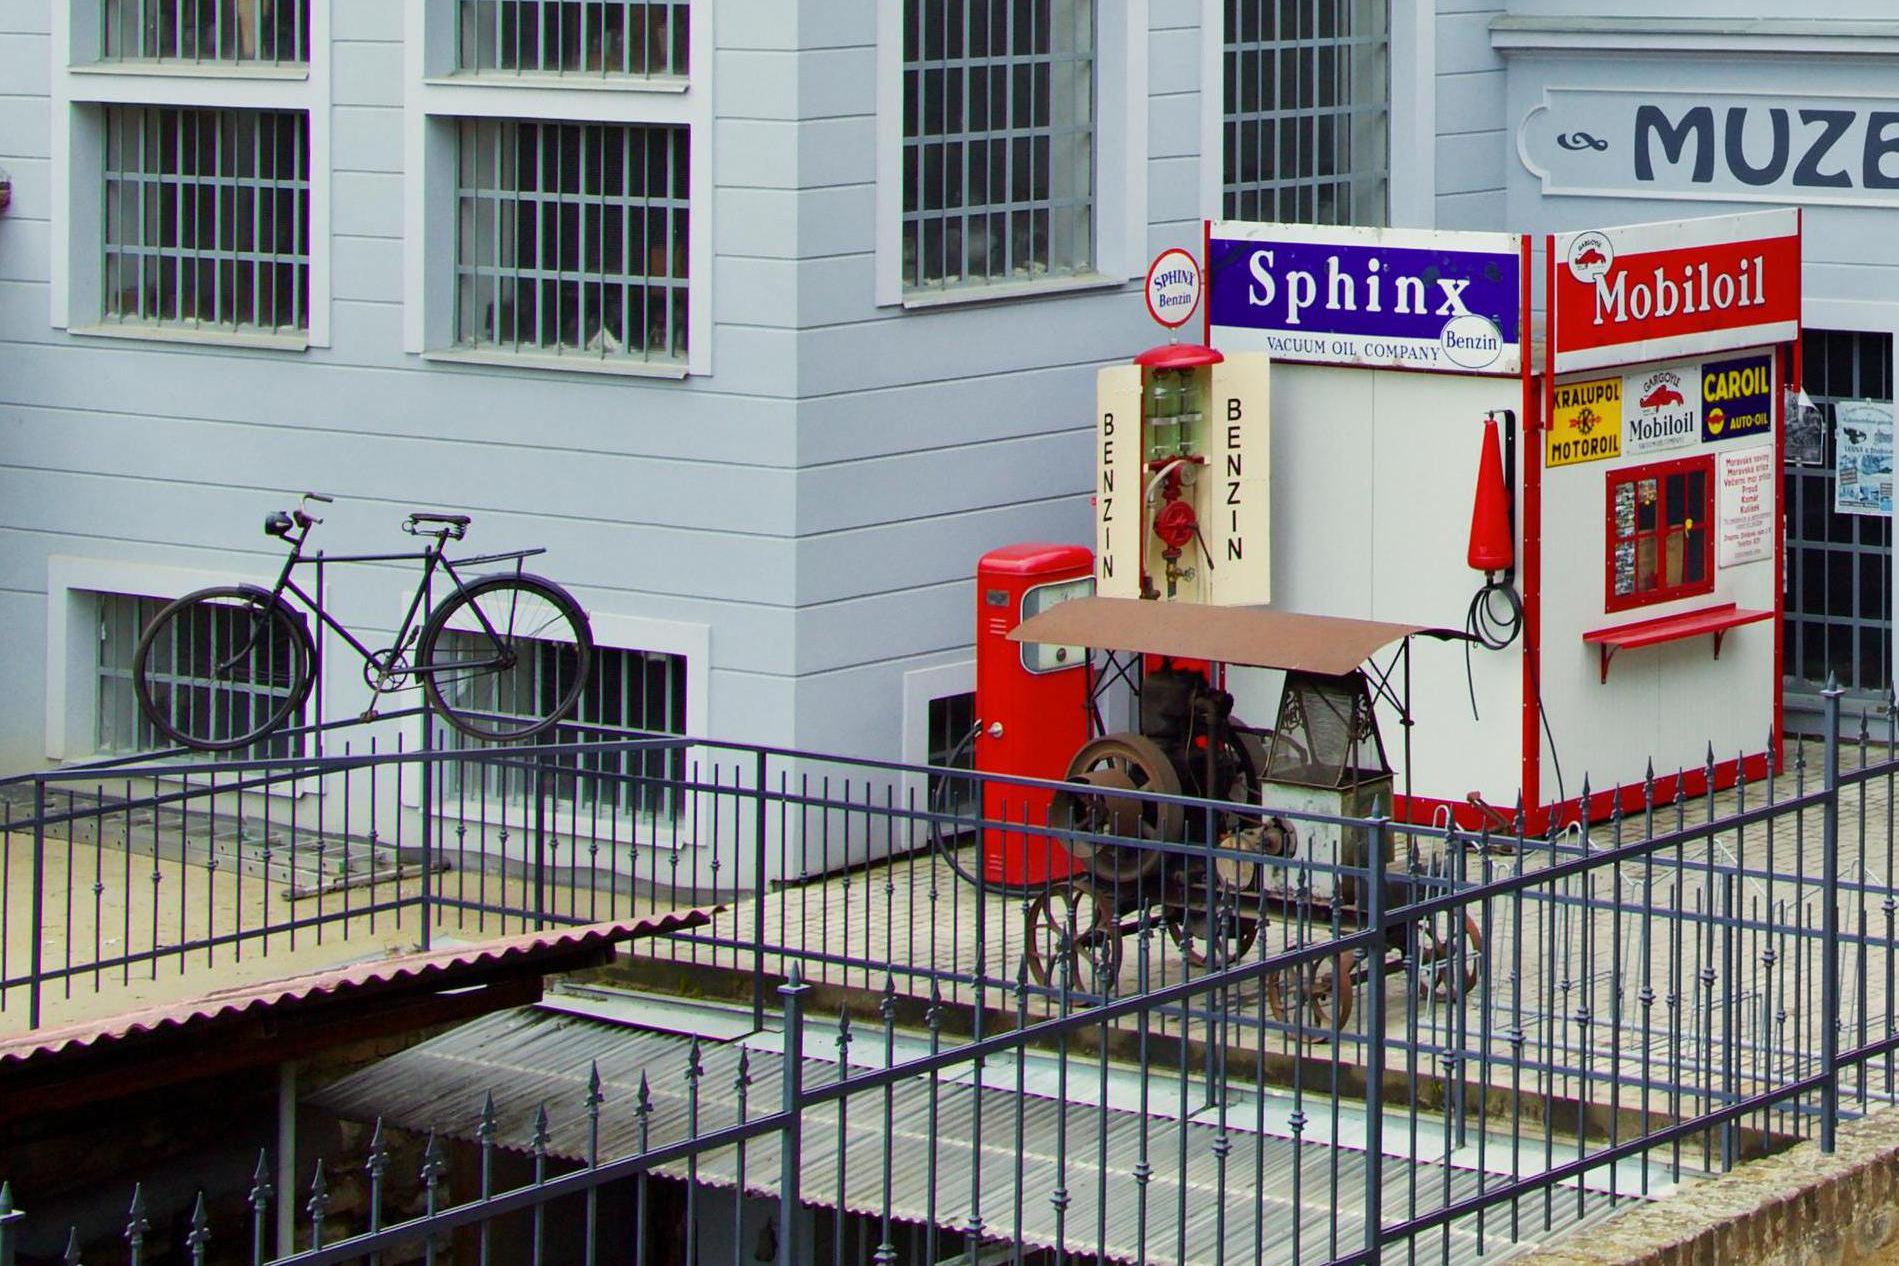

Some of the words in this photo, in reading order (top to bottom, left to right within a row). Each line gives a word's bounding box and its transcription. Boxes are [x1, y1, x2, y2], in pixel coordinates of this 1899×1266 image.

[1154, 270, 1195, 291] SPHINX
[1249, 250, 1471, 324] Sphinx
[1592, 255, 1766, 326] Mobiloil
[1160, 293, 1191, 307] Benzin
[1267, 336, 1326, 354] VACUUM
[1332, 341, 1357, 356] OIL
[1364, 343, 1440, 361] COMPANY
[1446, 330, 1498, 351] Benzin
[1643, 372, 1681, 392] GARGOYLE
[1703, 366, 1769, 403] CAROIL
[1554, 384, 1619, 409] KRALUPOL
[1629, 411, 1694, 442] Mobiloil
[1730, 413, 1769, 430] AUTO-OIL
[1552, 434, 1619, 462] MOTOROIL
[1227, 398, 1242, 561] BENZIN
[1103, 413, 1114, 578] BENZIN
